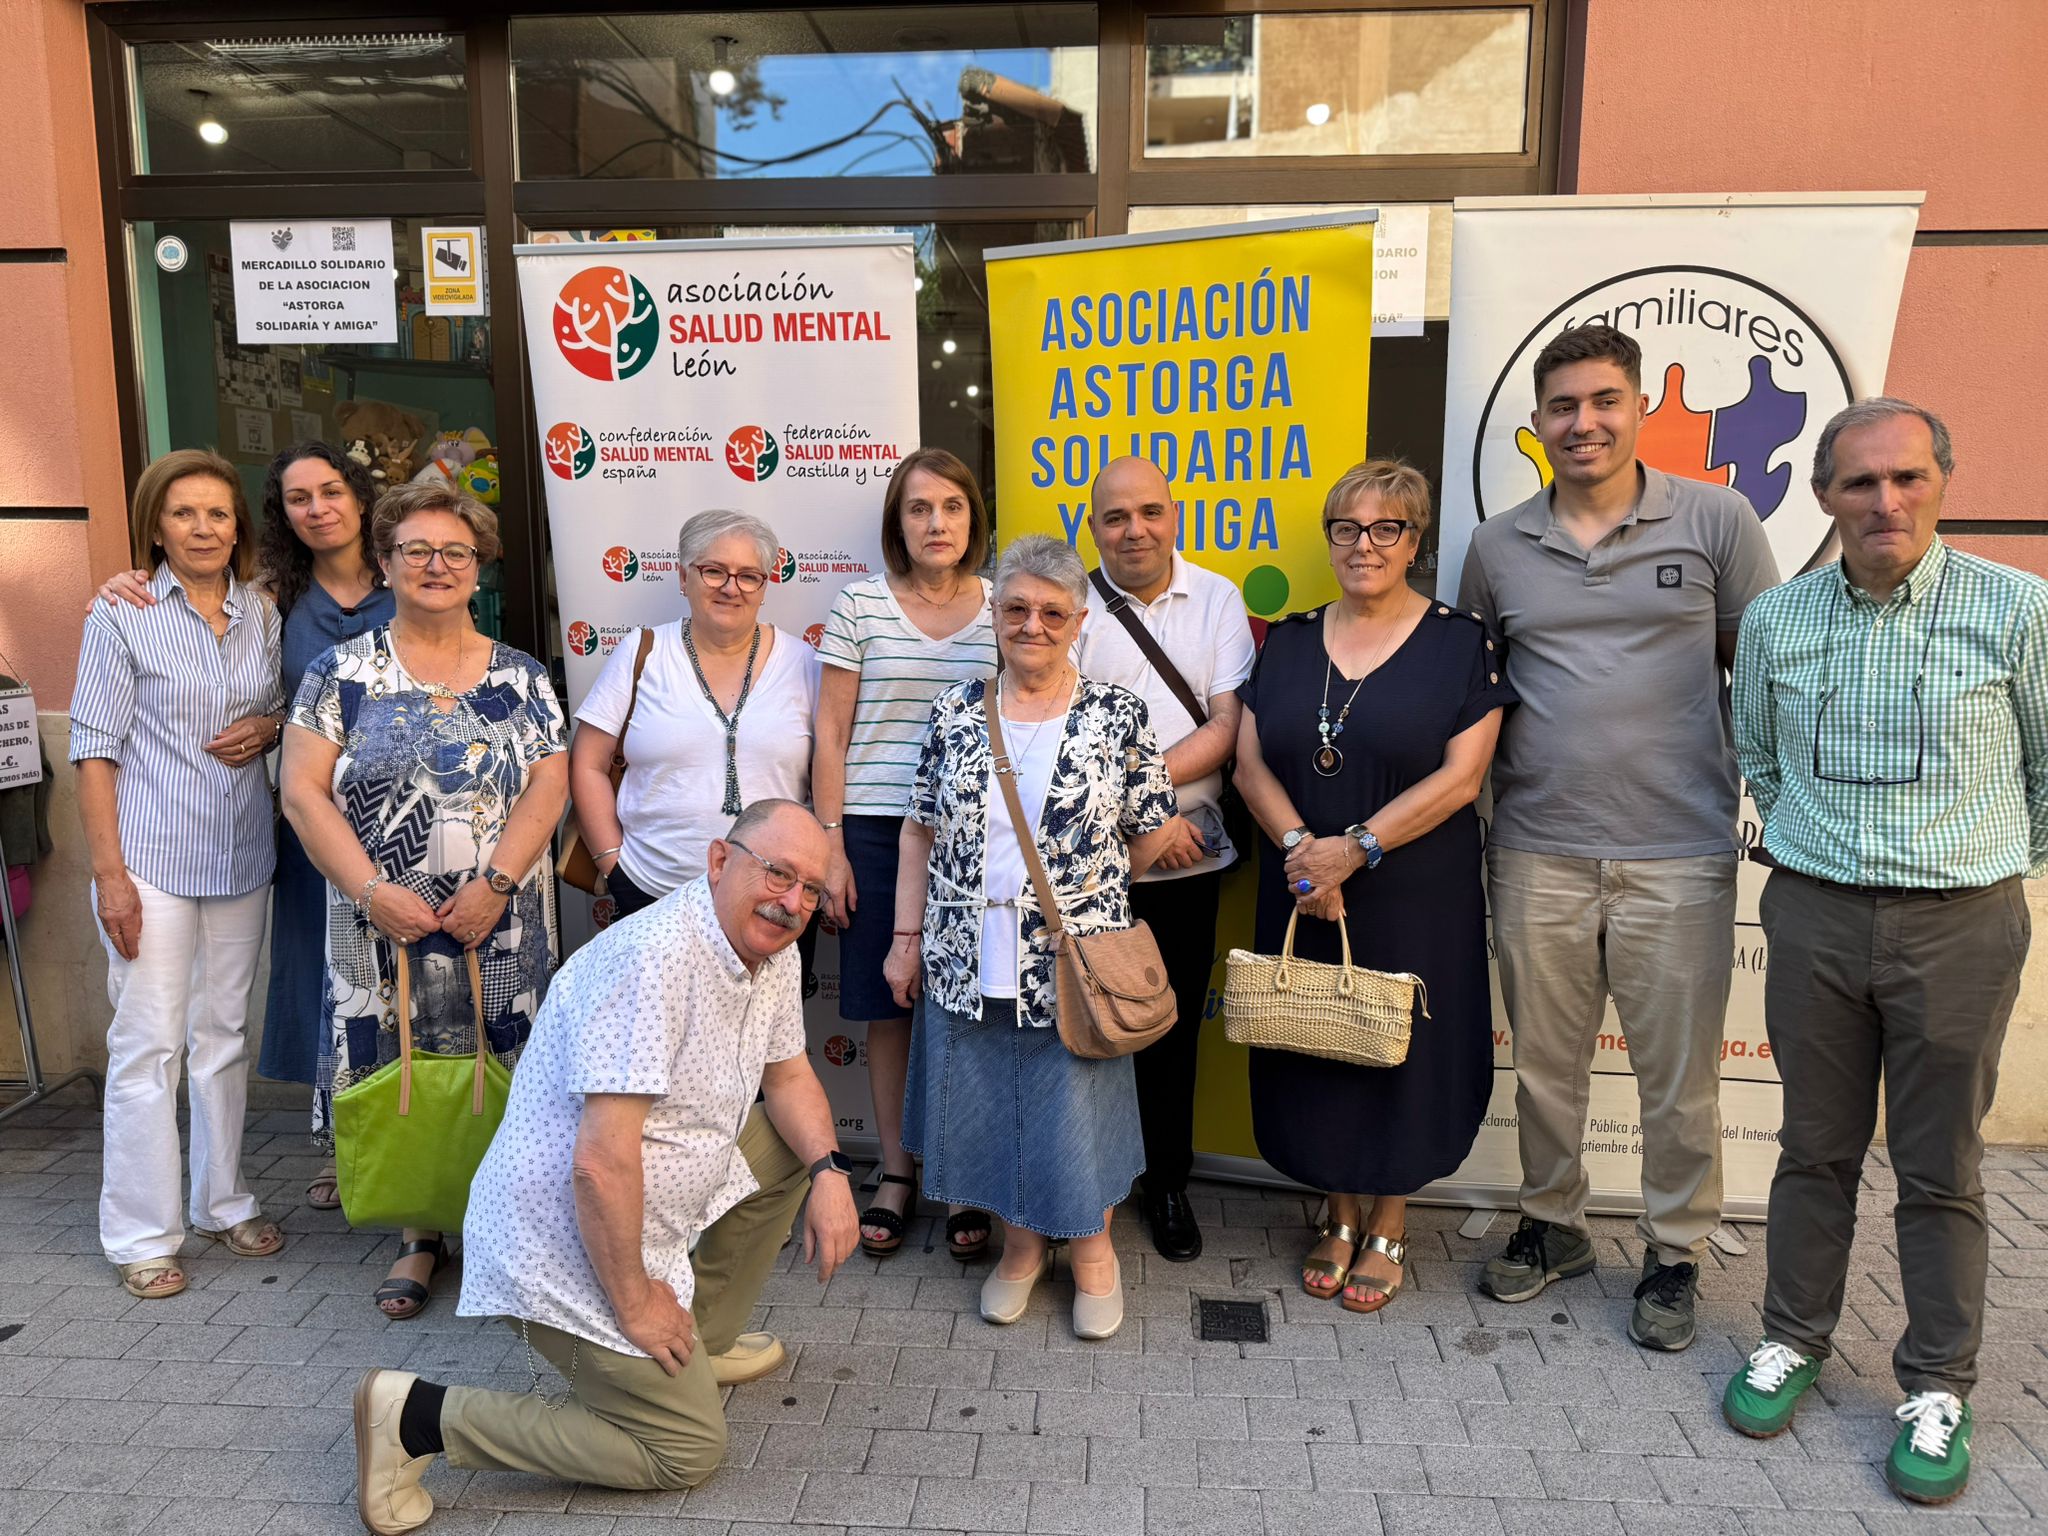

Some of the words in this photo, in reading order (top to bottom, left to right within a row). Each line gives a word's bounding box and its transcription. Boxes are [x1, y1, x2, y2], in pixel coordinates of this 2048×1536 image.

[241, 260, 317, 270] MERCADILLO
[320, 259, 385, 270] SOLIDARIO
[259, 281, 275, 290] DE
[278, 281, 293, 290] LA
[296, 280, 370, 290] ASOCIACION
[667, 271, 834, 303] asociación
[1040, 266, 1311, 352] ASOCIACIÓN
[324, 320, 331, 330] Y
[669, 313, 763, 343] SALUD
[774, 311, 890, 342] MENTAL
[673, 349, 736, 378] león
[1049, 352, 1293, 420] ASTORGA
[599, 426, 712, 447] confederación
[783, 423, 871, 444] federación
[600, 447, 649, 462] SALUD
[653, 446, 714, 461] MENTAL
[785, 444, 834, 460] SALUD
[839, 444, 901, 460] MENTAL
[602, 465, 657, 485] españa
[786, 462, 849, 478] Castilla
[856, 467, 867, 485] y
[873, 462, 900, 478] Le
[1057, 503, 1087, 549] Y
[798, 550, 852, 561] asociación
[641, 562, 672, 571] SALUD
[798, 562, 829, 573] SALUD
[832, 563, 869, 573] MENTAL
[642, 572, 664, 582] león
[799, 573, 820, 583] león
[17, 720, 30, 730] DE
[1590, 1118, 1628, 1134] Pública
[1722, 1125, 1738, 1139] del
